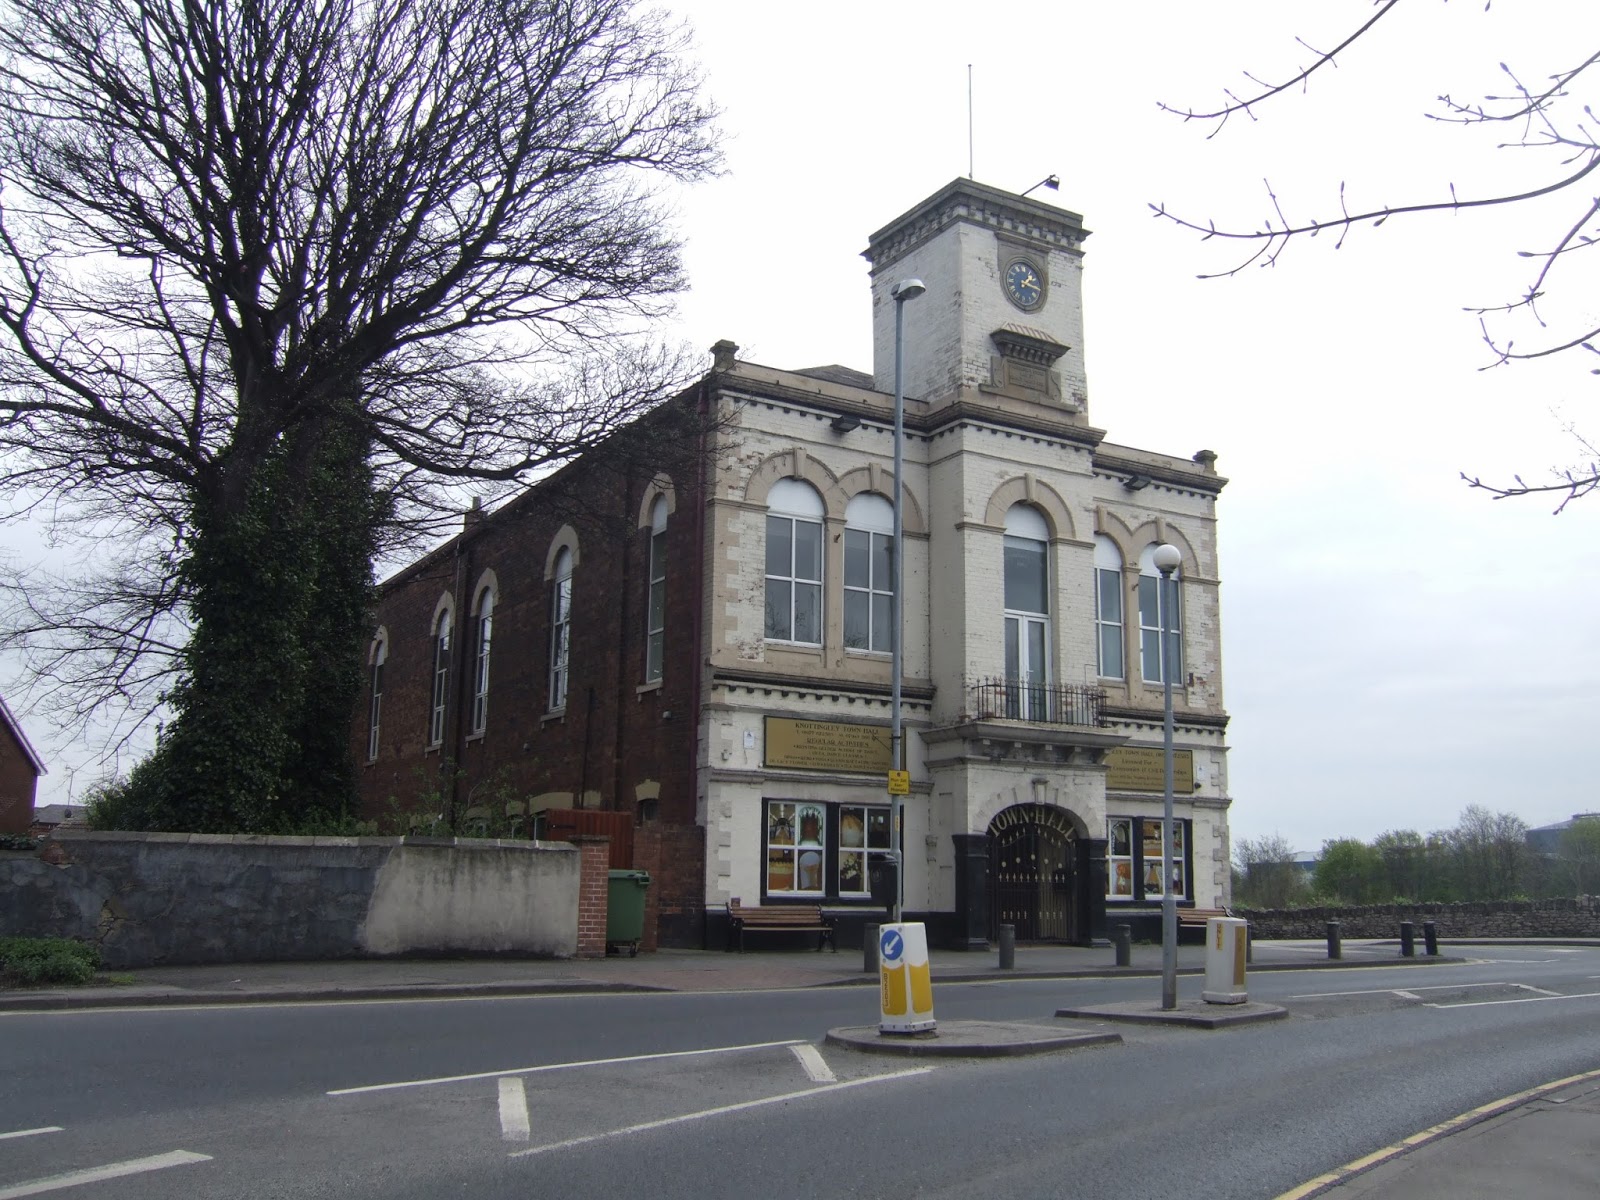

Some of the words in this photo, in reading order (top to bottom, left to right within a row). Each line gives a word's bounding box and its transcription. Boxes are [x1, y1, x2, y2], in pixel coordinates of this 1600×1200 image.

[795, 722, 840, 732] KNOTTINGLEY
[863, 728, 879, 736] HALL
[806, 737, 836, 745] REGULAR
[988, 806, 1029, 838] TOWN
[1035, 806, 1076, 843] HALL
